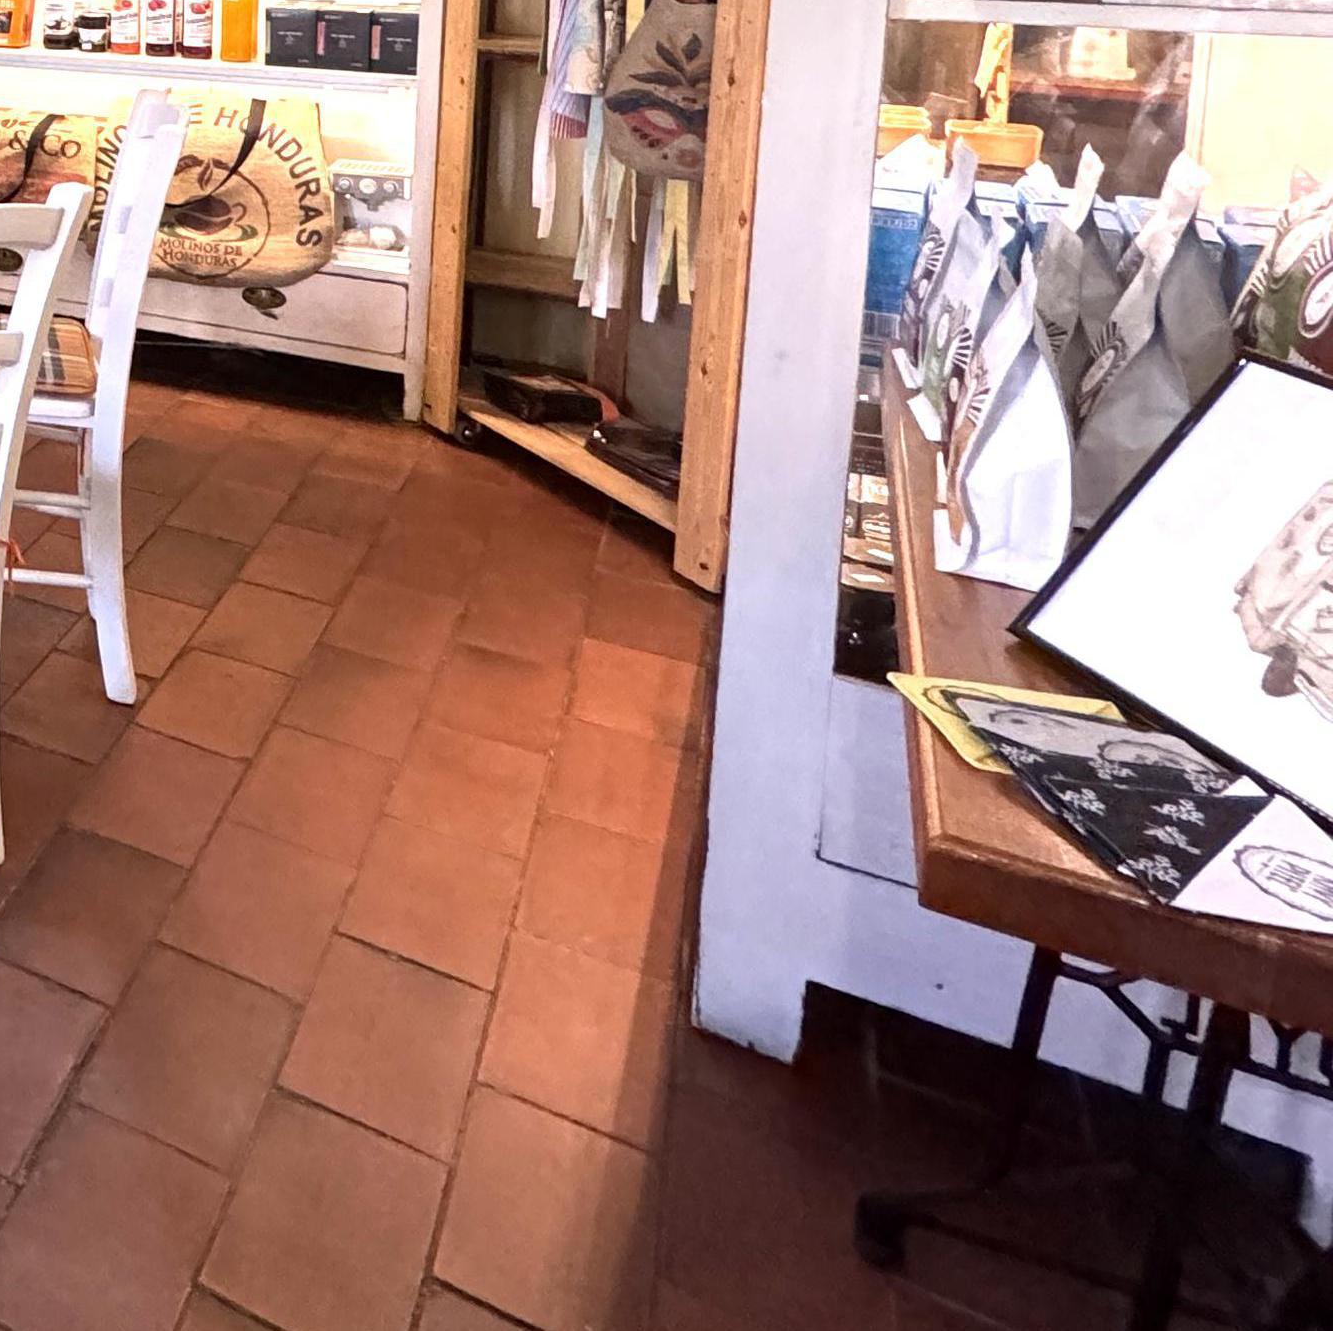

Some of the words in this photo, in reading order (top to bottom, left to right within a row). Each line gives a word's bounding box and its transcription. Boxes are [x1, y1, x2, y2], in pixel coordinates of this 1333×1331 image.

[188, 104, 202, 124] E
[158, 237, 222, 254] MOLINOS
[224, 244, 243, 256] DE
[162, 249, 238, 268] HONDURAS
